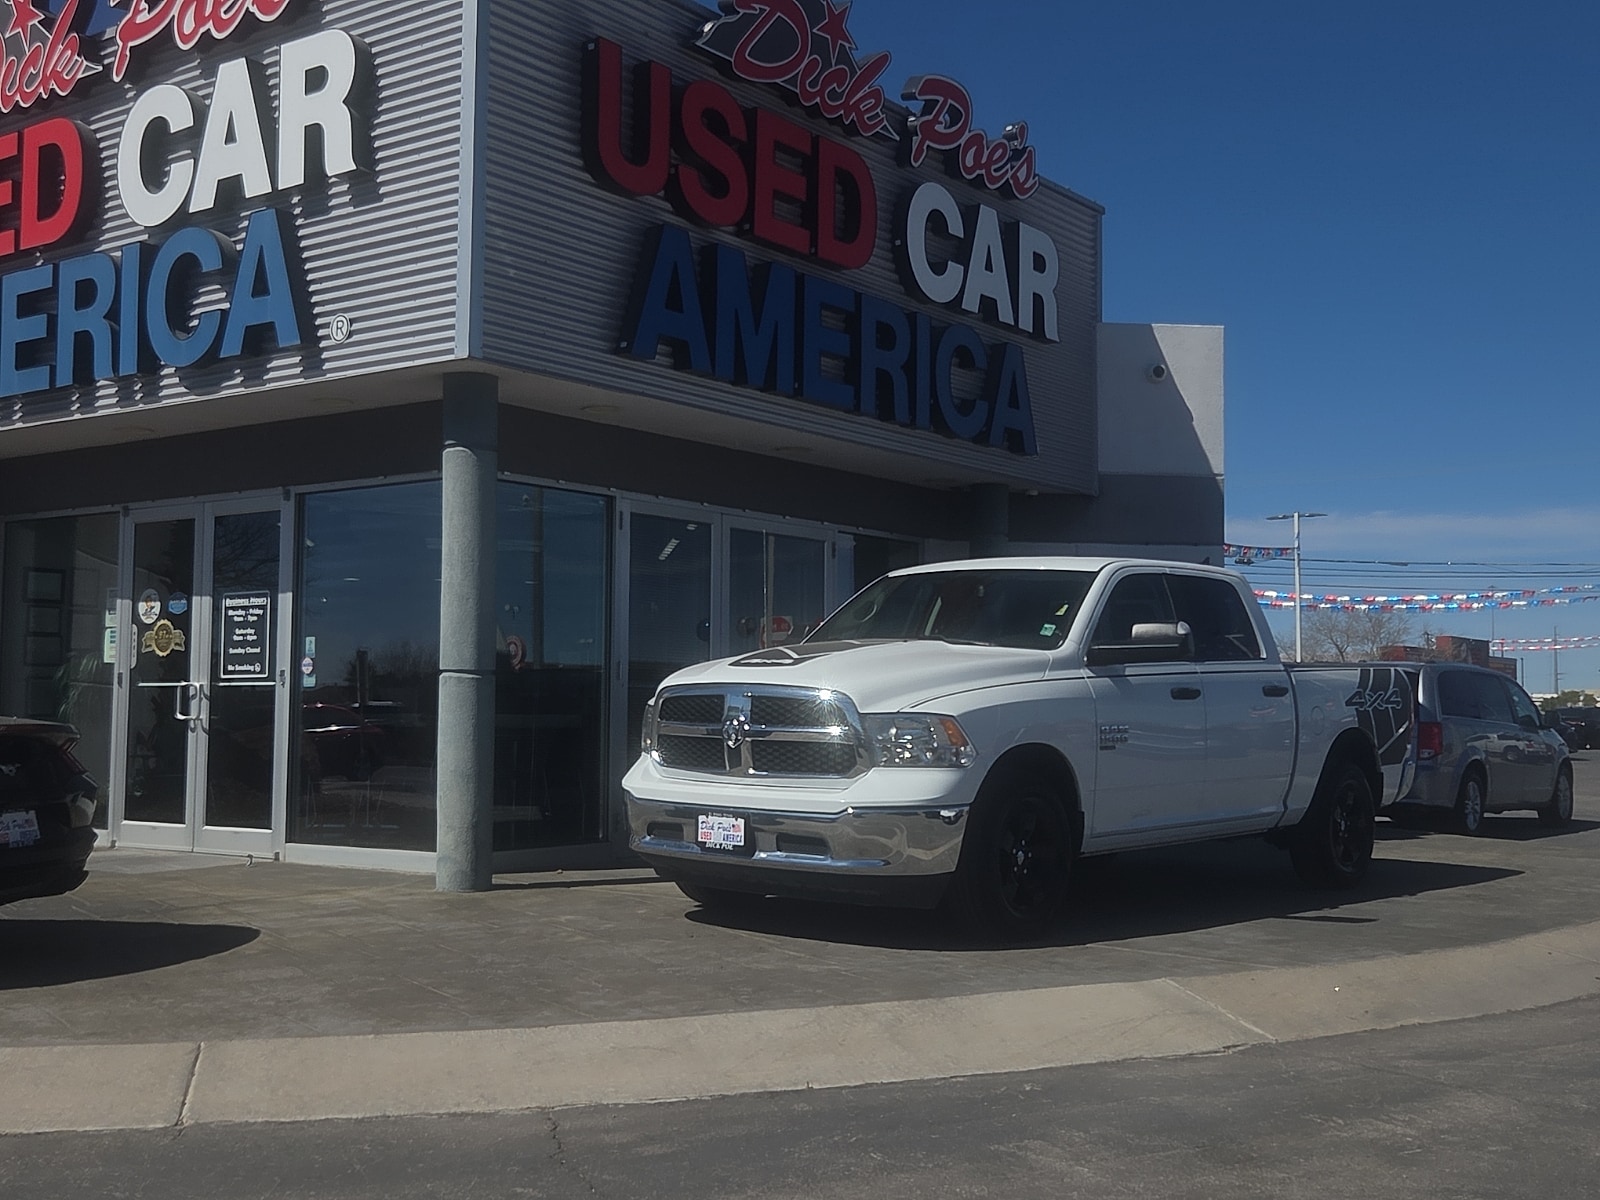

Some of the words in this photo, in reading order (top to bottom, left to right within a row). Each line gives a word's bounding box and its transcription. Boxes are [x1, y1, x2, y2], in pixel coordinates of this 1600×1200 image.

[117, 29, 358, 227] CAR
[599, 36, 879, 271] USED
[906, 182, 1061, 343] CAR
[730, 0, 892, 138] Dick
[908, 74, 1040, 199] Poe's
[630, 224, 1039, 457] AMERICA
